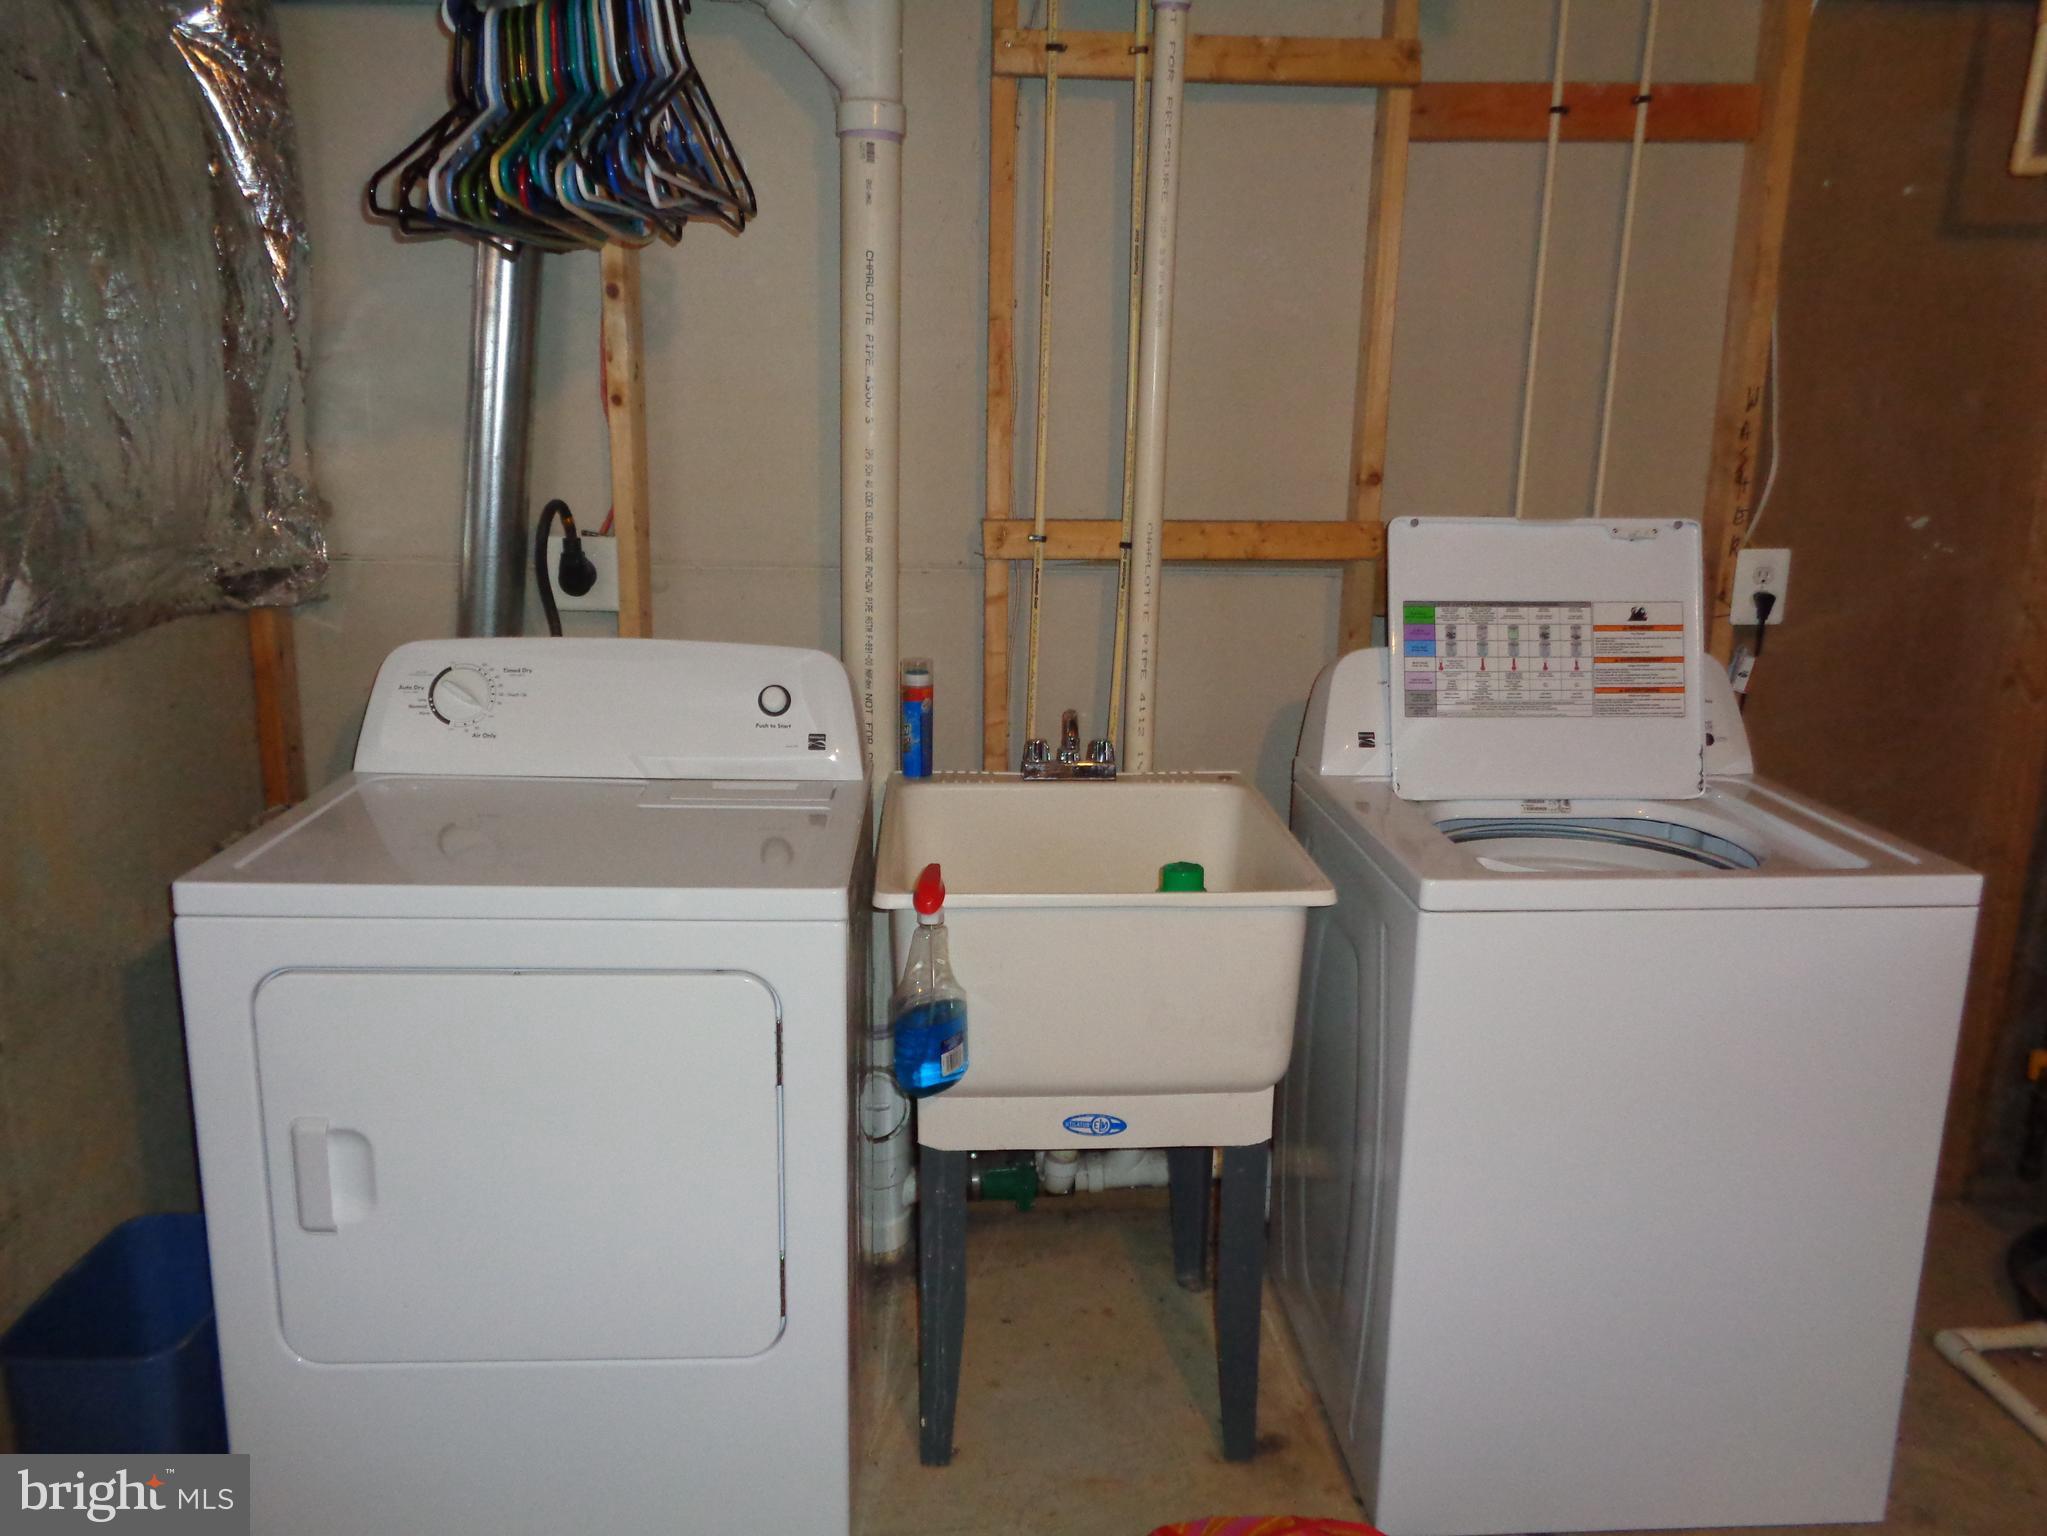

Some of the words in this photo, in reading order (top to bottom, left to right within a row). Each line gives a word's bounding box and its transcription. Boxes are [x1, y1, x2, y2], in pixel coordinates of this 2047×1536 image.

[865, 249, 875, 326] CHARLOTTE
[865, 333, 875, 366] PIPE
[864, 546, 874, 563] CORE
[1142, 522, 1154, 625] CHARLOTTE
[864, 597, 874, 614] PIPE
[1139, 633, 1149, 681] PIPE
[413, 684, 425, 692] Dry
[864, 692, 874, 714] NOT
